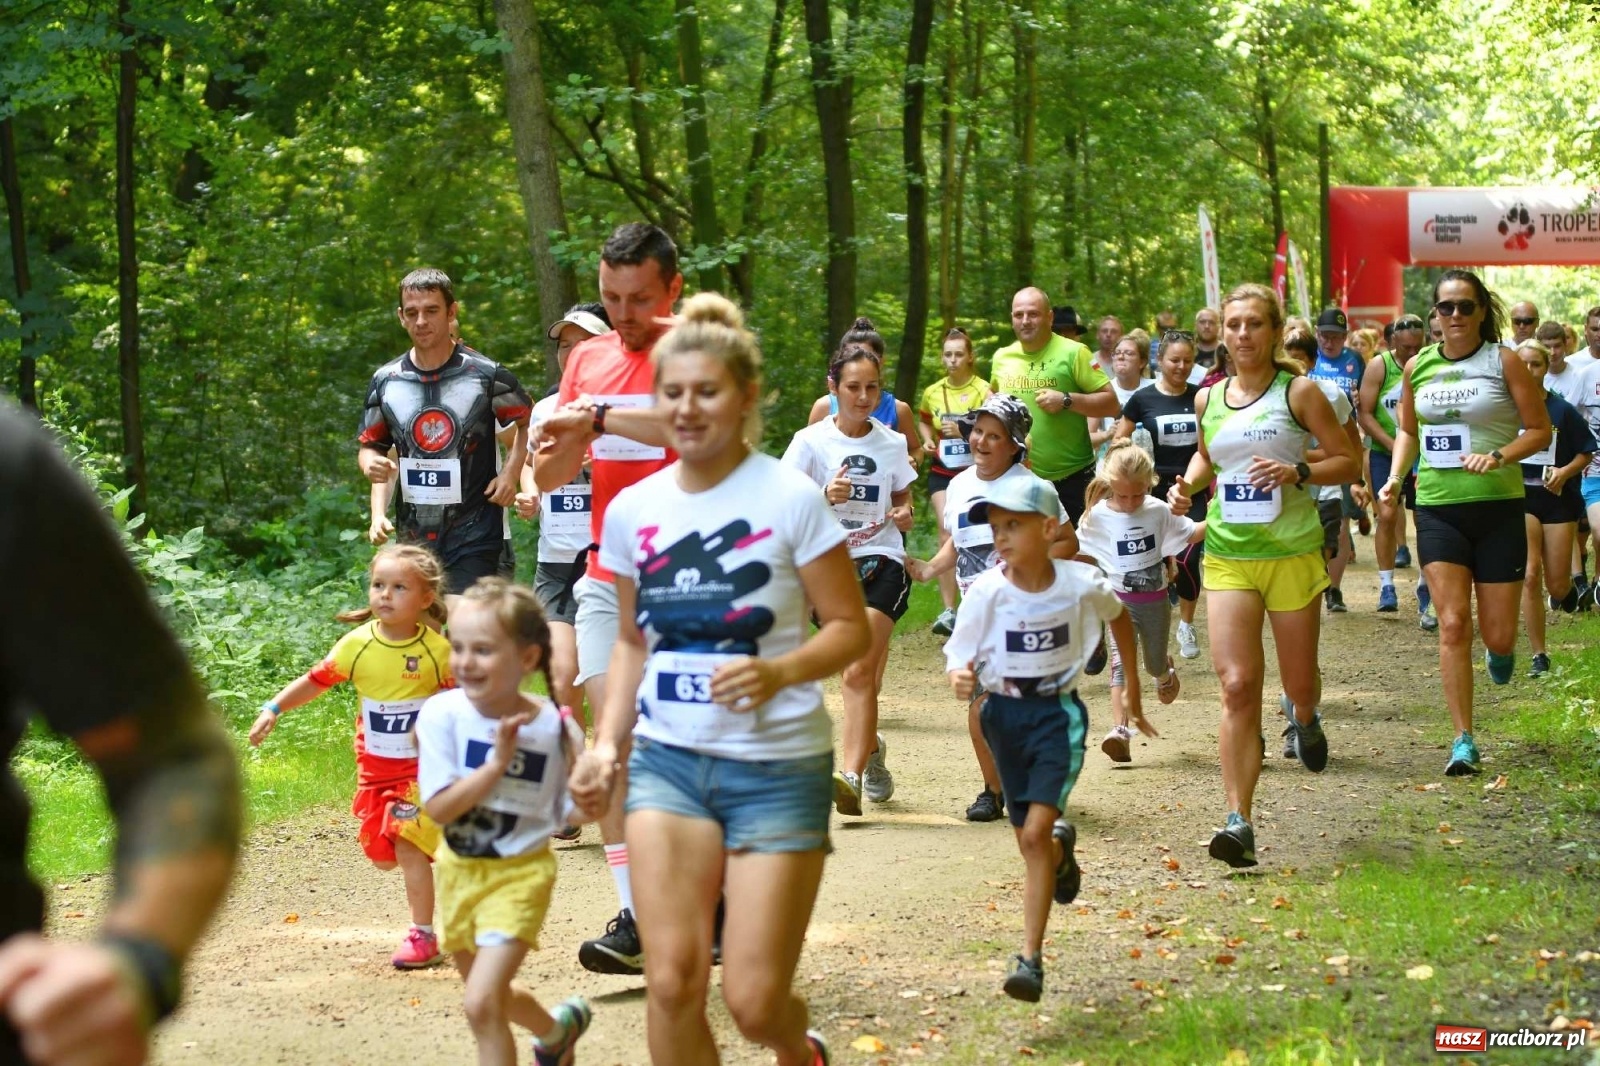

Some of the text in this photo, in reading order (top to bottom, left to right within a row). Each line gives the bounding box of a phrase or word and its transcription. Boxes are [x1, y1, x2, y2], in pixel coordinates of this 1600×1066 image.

[1422, 387, 1478, 400] AKTYWNI
[1171, 422, 1188, 433] 90
[951, 444, 966, 454] 85
[1431, 437, 1450, 450] 38
[418, 472, 438, 485] 18
[1235, 485, 1256, 500] 37
[563, 496, 584, 510] 59
[1126, 538, 1147, 554] 94
[1022, 630, 1055, 651] 92
[674, 674, 711, 701] 63
[383, 714, 411, 732] 77
